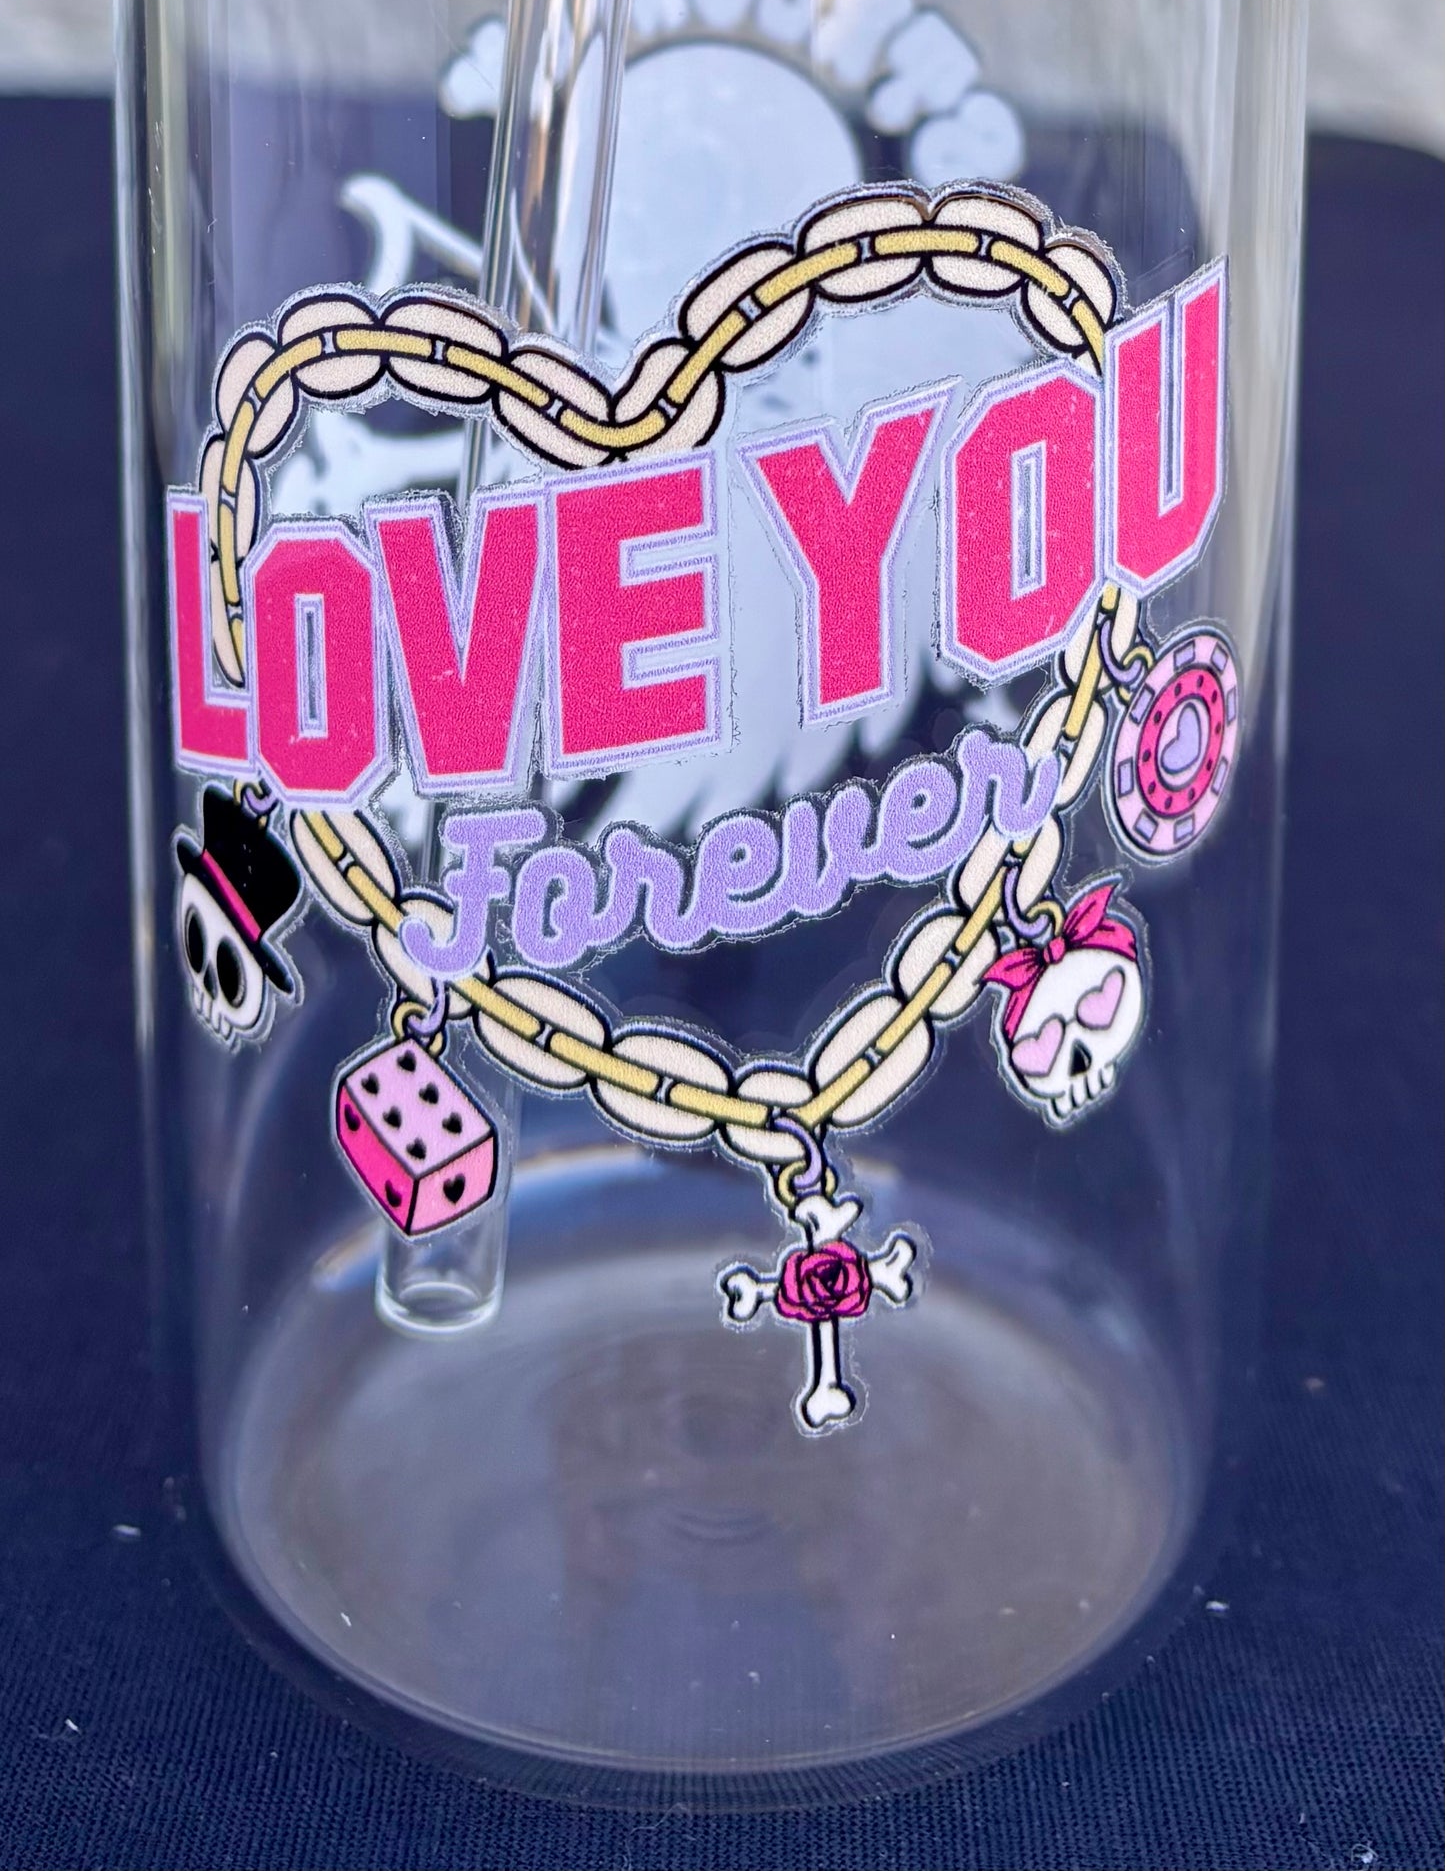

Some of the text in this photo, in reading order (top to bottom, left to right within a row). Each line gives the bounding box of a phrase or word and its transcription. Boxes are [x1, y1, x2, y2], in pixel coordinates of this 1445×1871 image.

[168, 259, 1227, 809] LOVE YOU
[402, 730, 1060, 978] Forever
